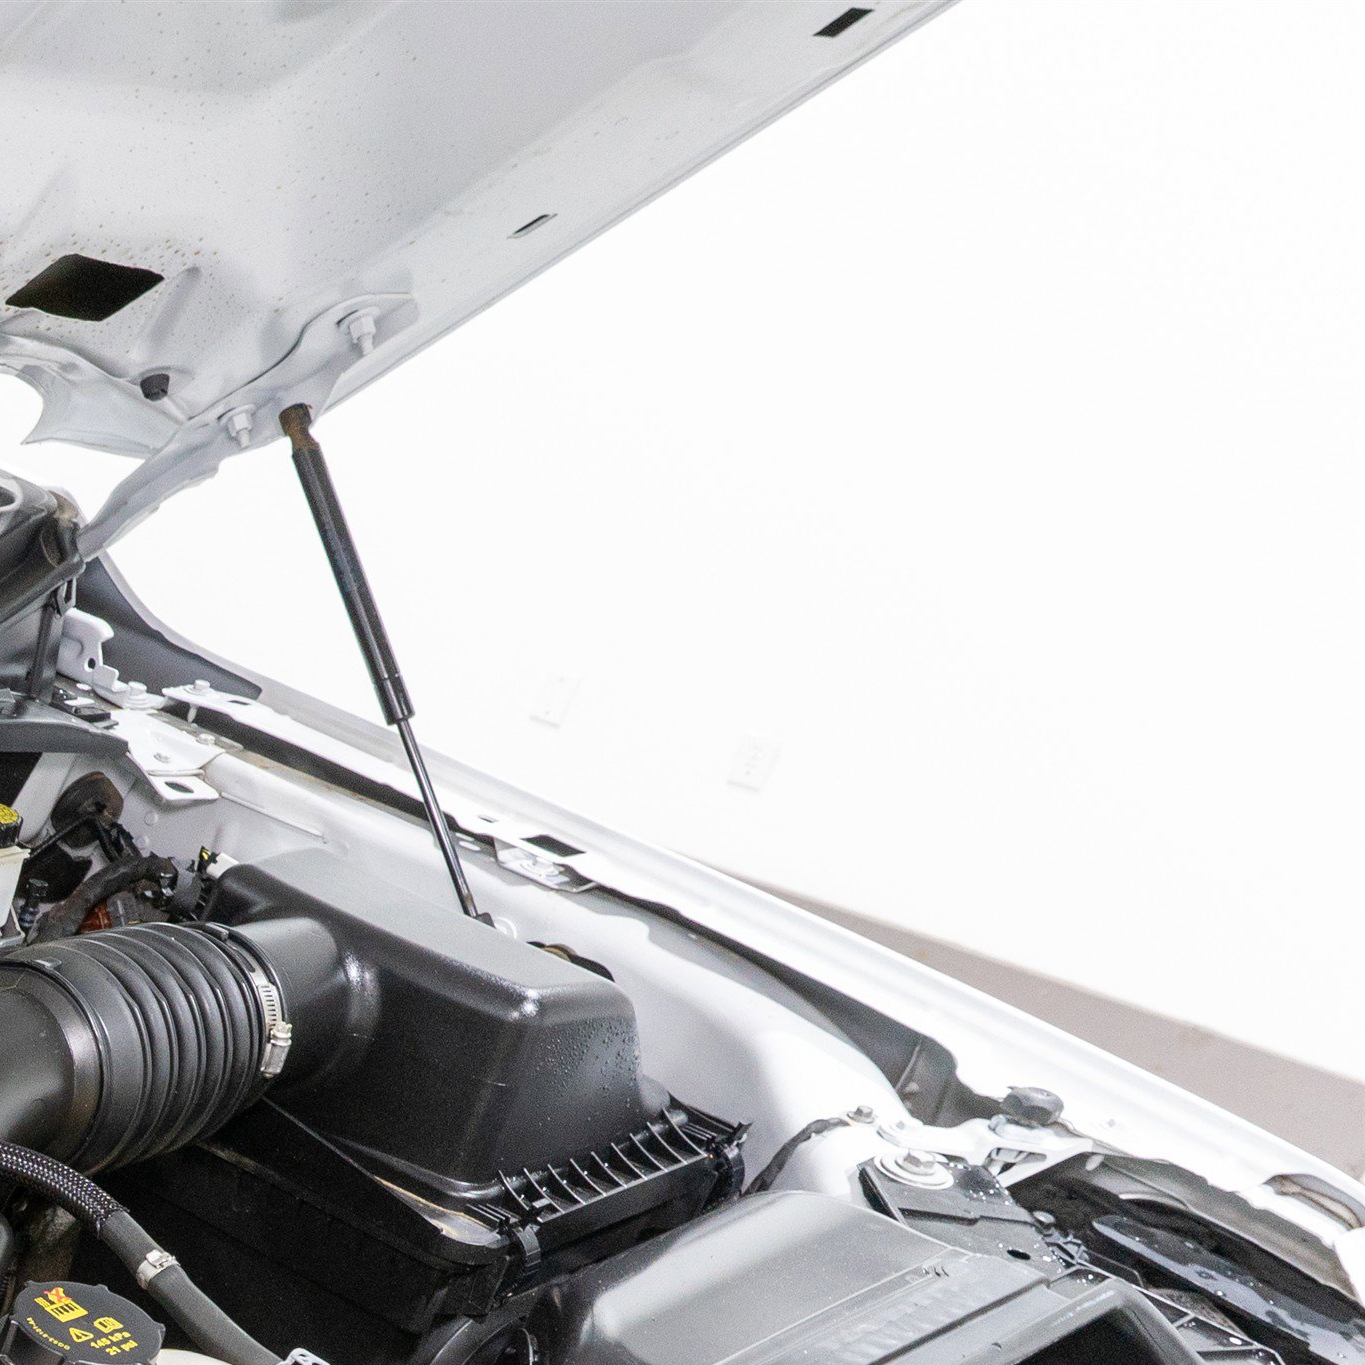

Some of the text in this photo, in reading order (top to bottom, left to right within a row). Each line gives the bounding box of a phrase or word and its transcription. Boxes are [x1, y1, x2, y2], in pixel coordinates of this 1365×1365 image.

[90, 1331, 132, 1349] 145 kPa
[105, 1339, 139, 1356] 21 psi
